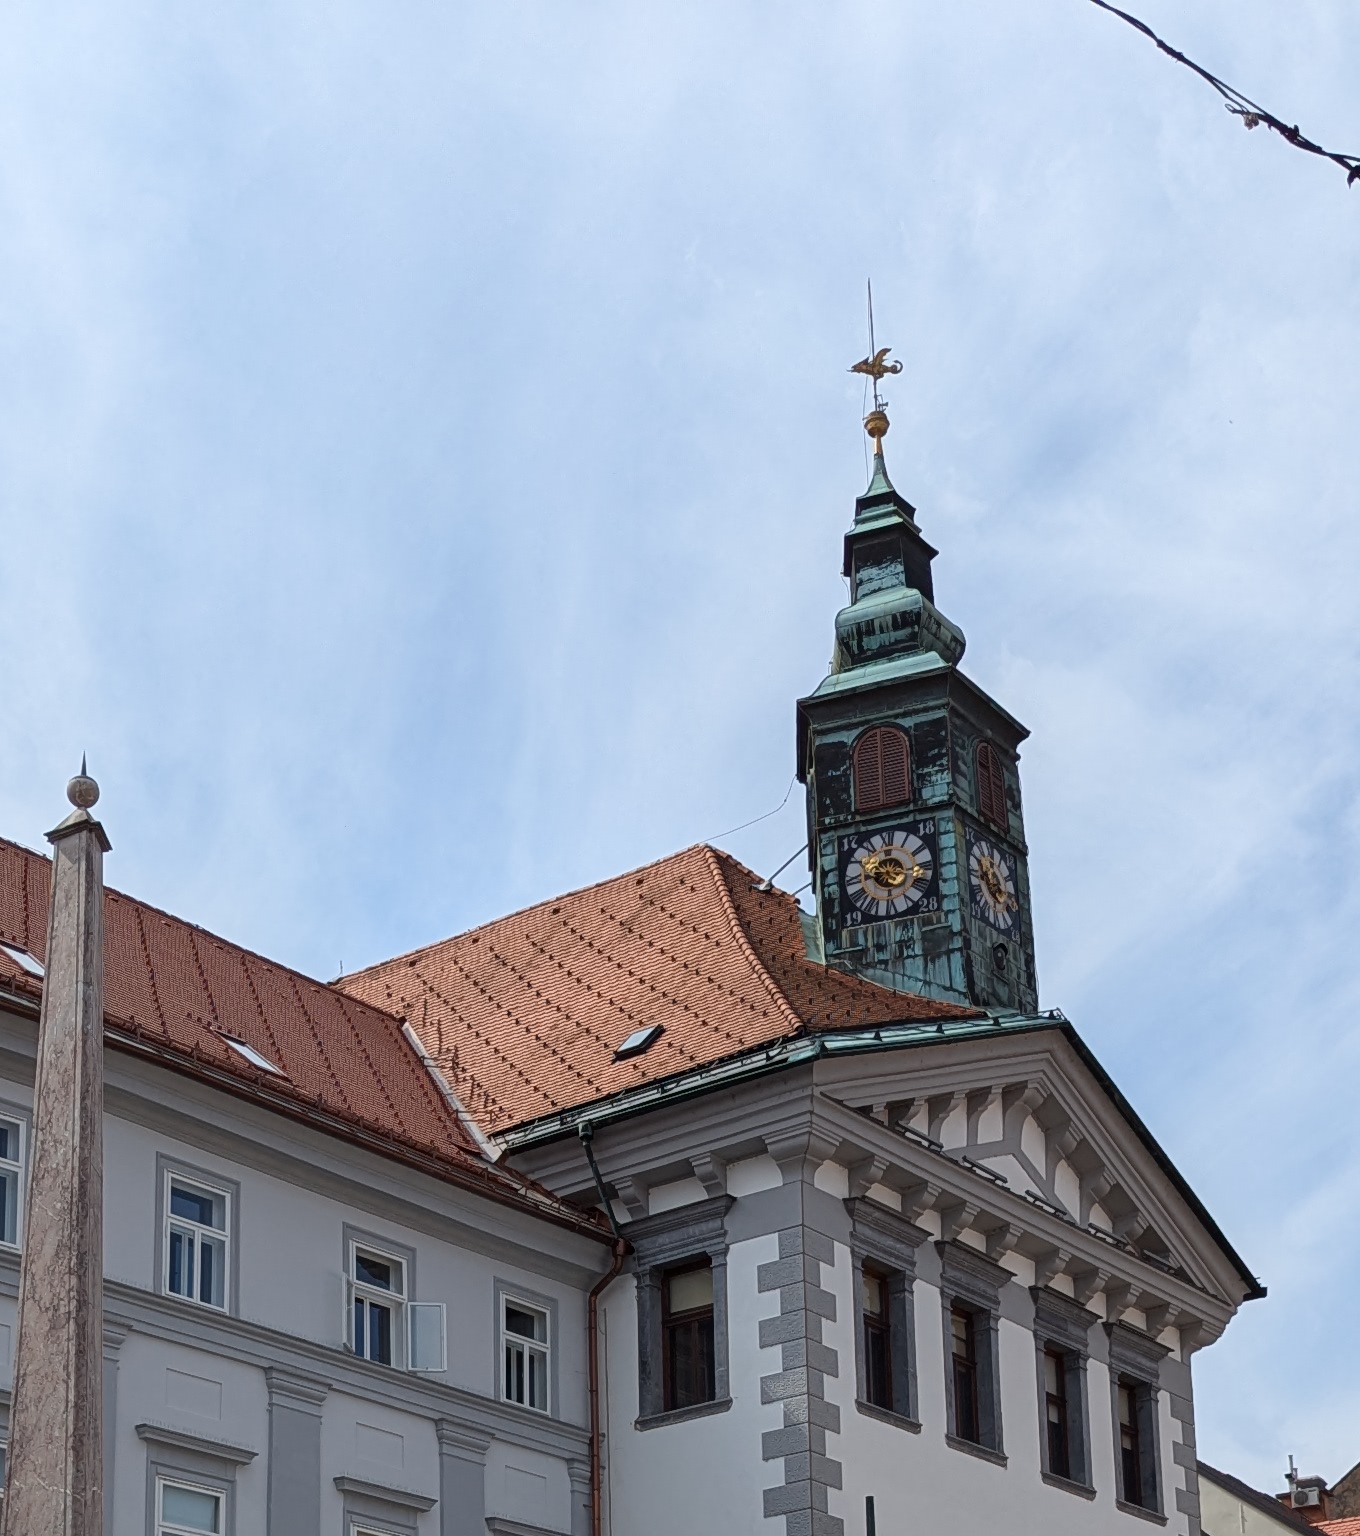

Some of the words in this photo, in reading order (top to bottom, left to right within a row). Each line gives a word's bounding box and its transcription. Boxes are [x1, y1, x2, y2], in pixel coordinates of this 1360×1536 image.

[917, 820, 934, 836] 18
[841, 835, 858, 851] 17
[919, 896, 937, 912] 28
[844, 911, 861, 927] 19
